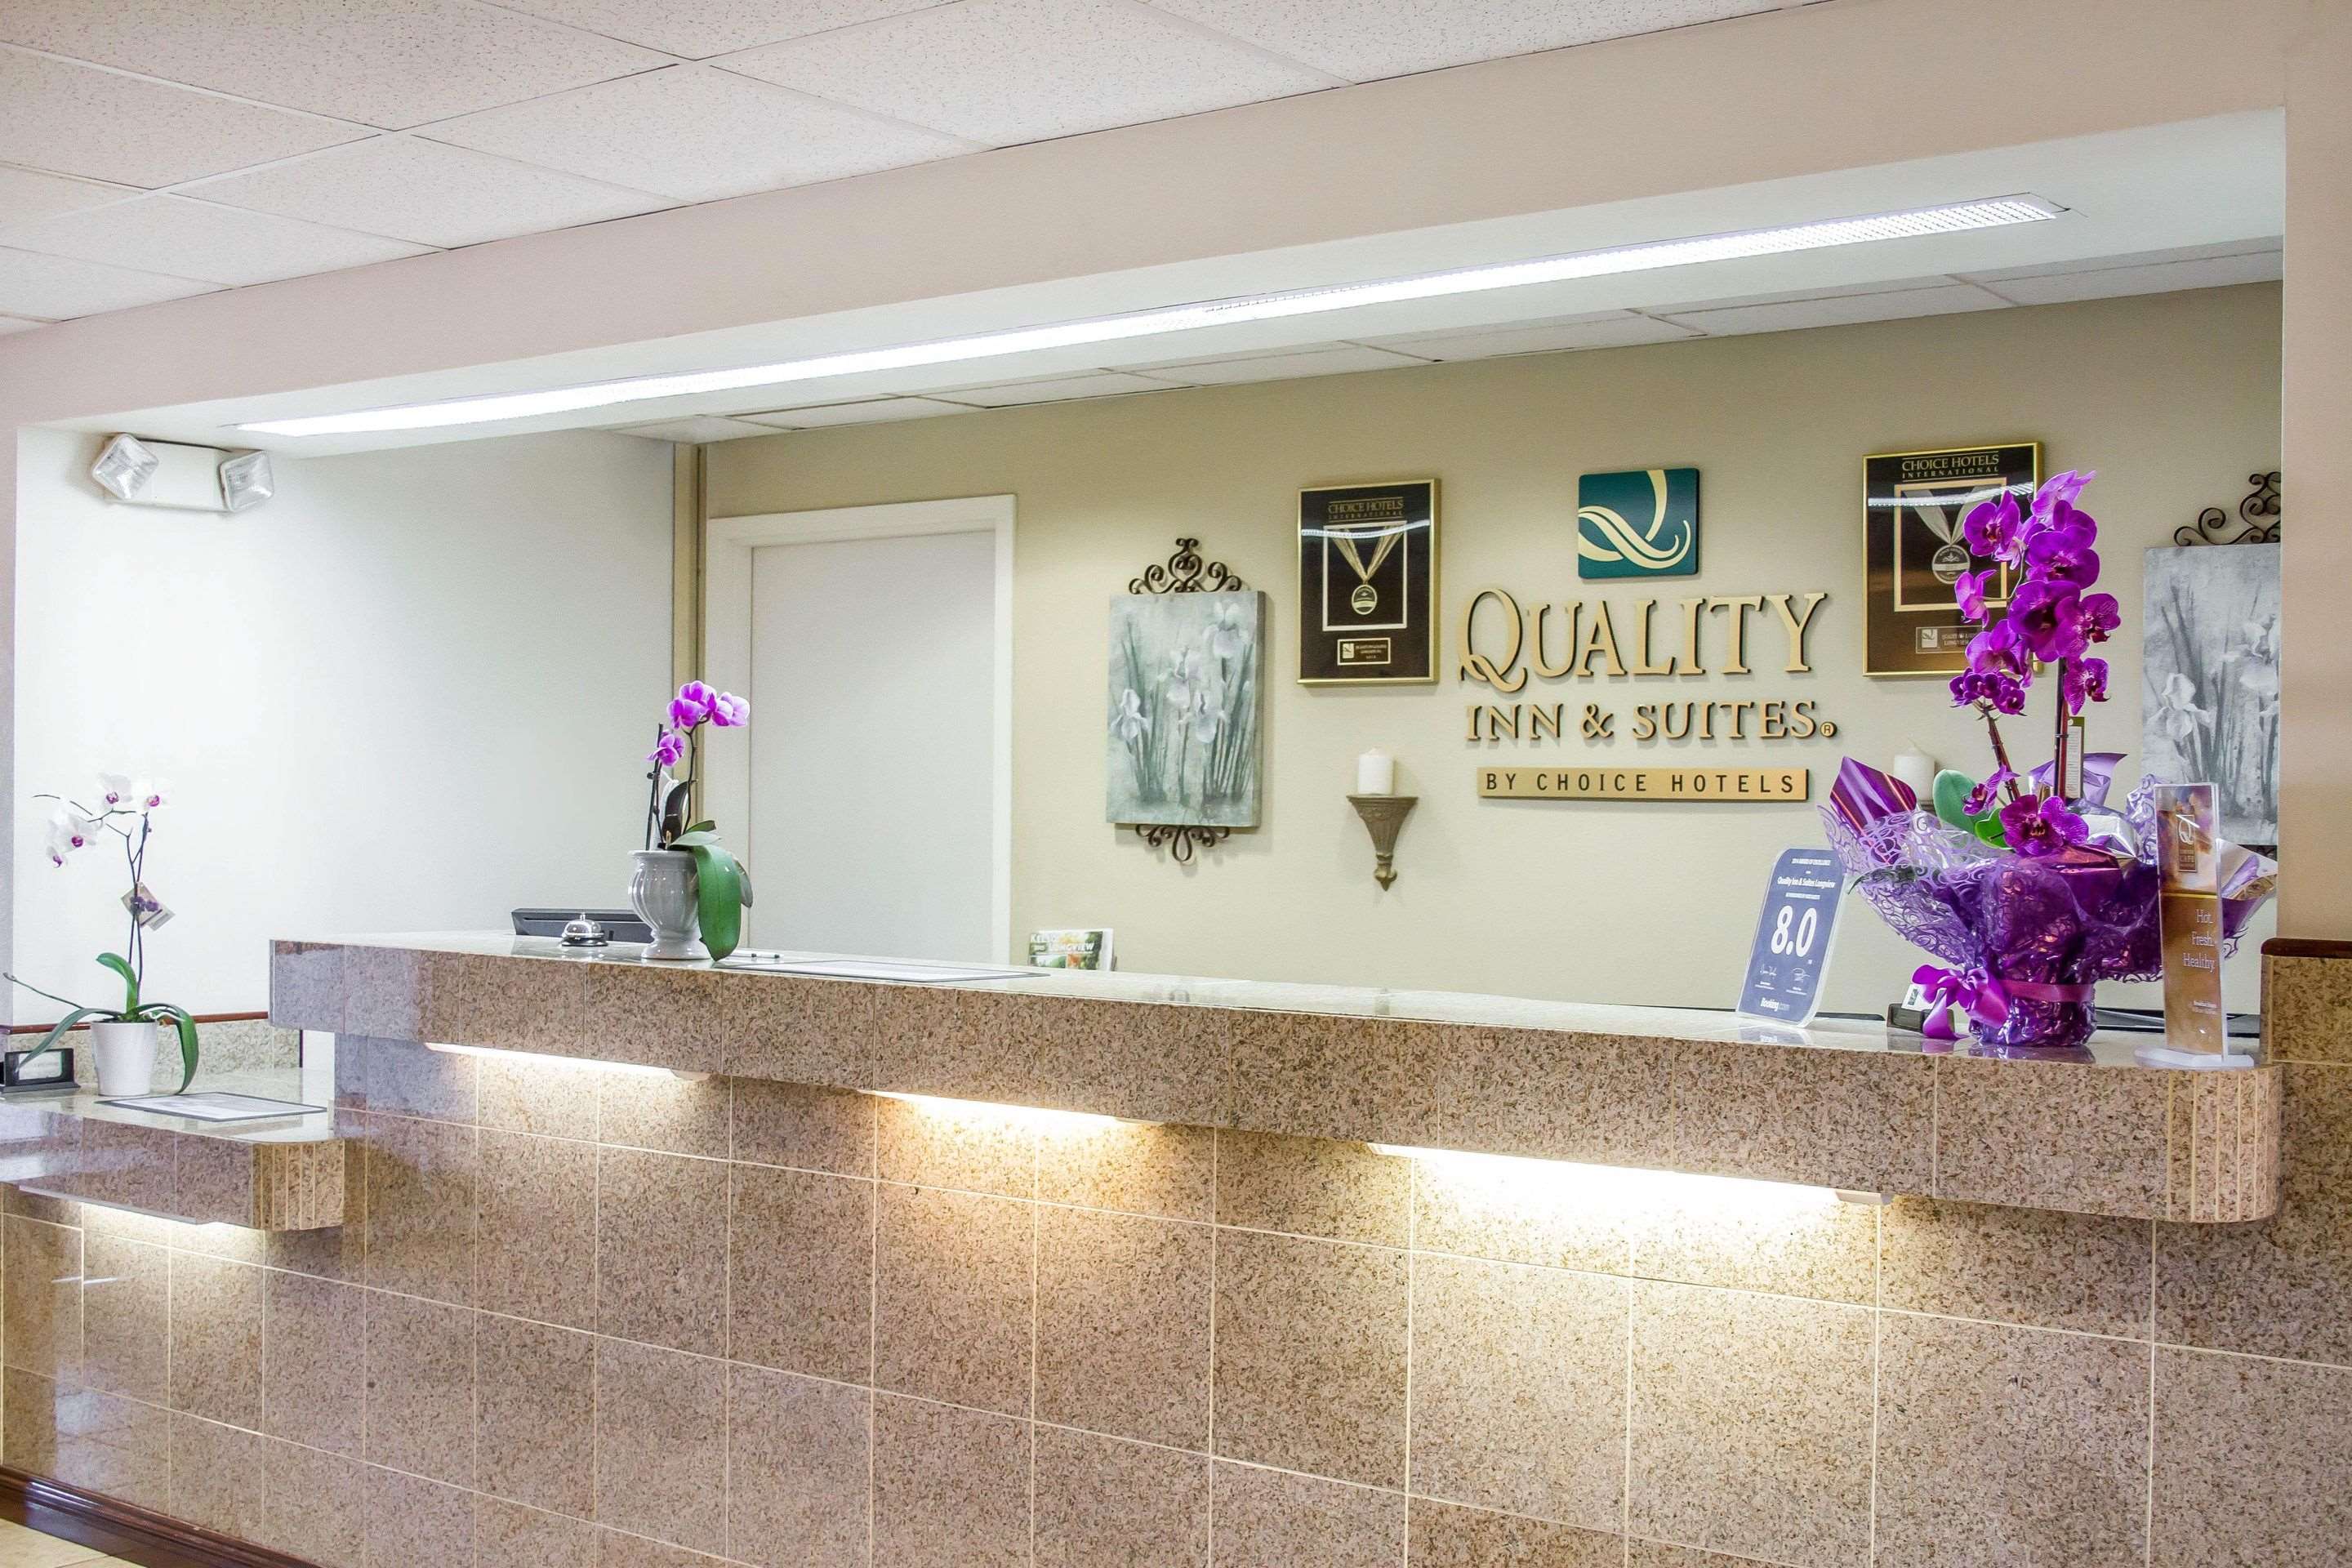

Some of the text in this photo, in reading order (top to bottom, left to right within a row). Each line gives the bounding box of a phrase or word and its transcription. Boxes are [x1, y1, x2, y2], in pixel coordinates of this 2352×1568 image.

[1902, 454, 1999, 471] CHOICE HOTELS
[1902, 466, 1998, 479] INTERNATIONAL
[1328, 499, 1403, 514] CHOICE HOTELS
[1458, 587, 1827, 692] QUALITY
[1465, 703, 1565, 741] INN
[1581, 703, 1615, 738] &
[1486, 773, 1795, 794] BY CHOICE HOTELS
[1771, 905, 1817, 957] 8.0
